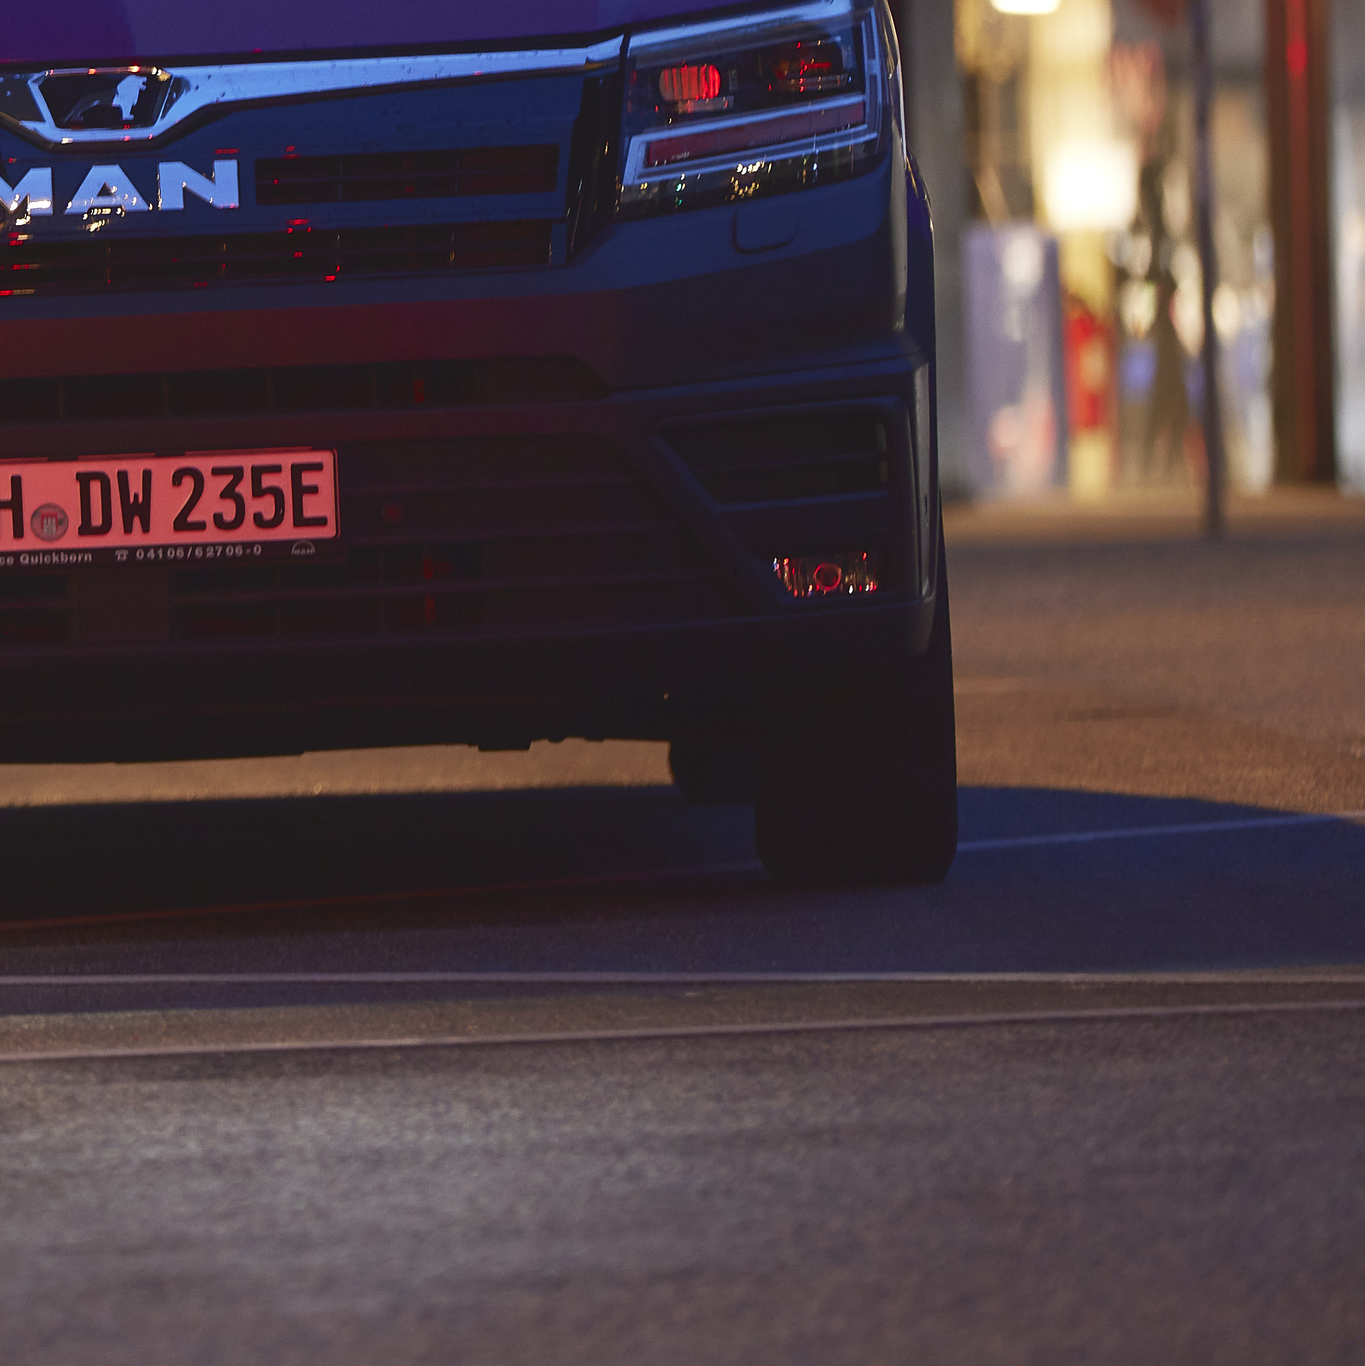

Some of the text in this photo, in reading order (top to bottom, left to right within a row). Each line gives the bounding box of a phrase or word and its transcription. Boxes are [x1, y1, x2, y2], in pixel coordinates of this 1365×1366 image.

[75, 468, 154, 536] DW
[171, 461, 330, 533] 235E
[19, 550, 94, 567] Quickborn
